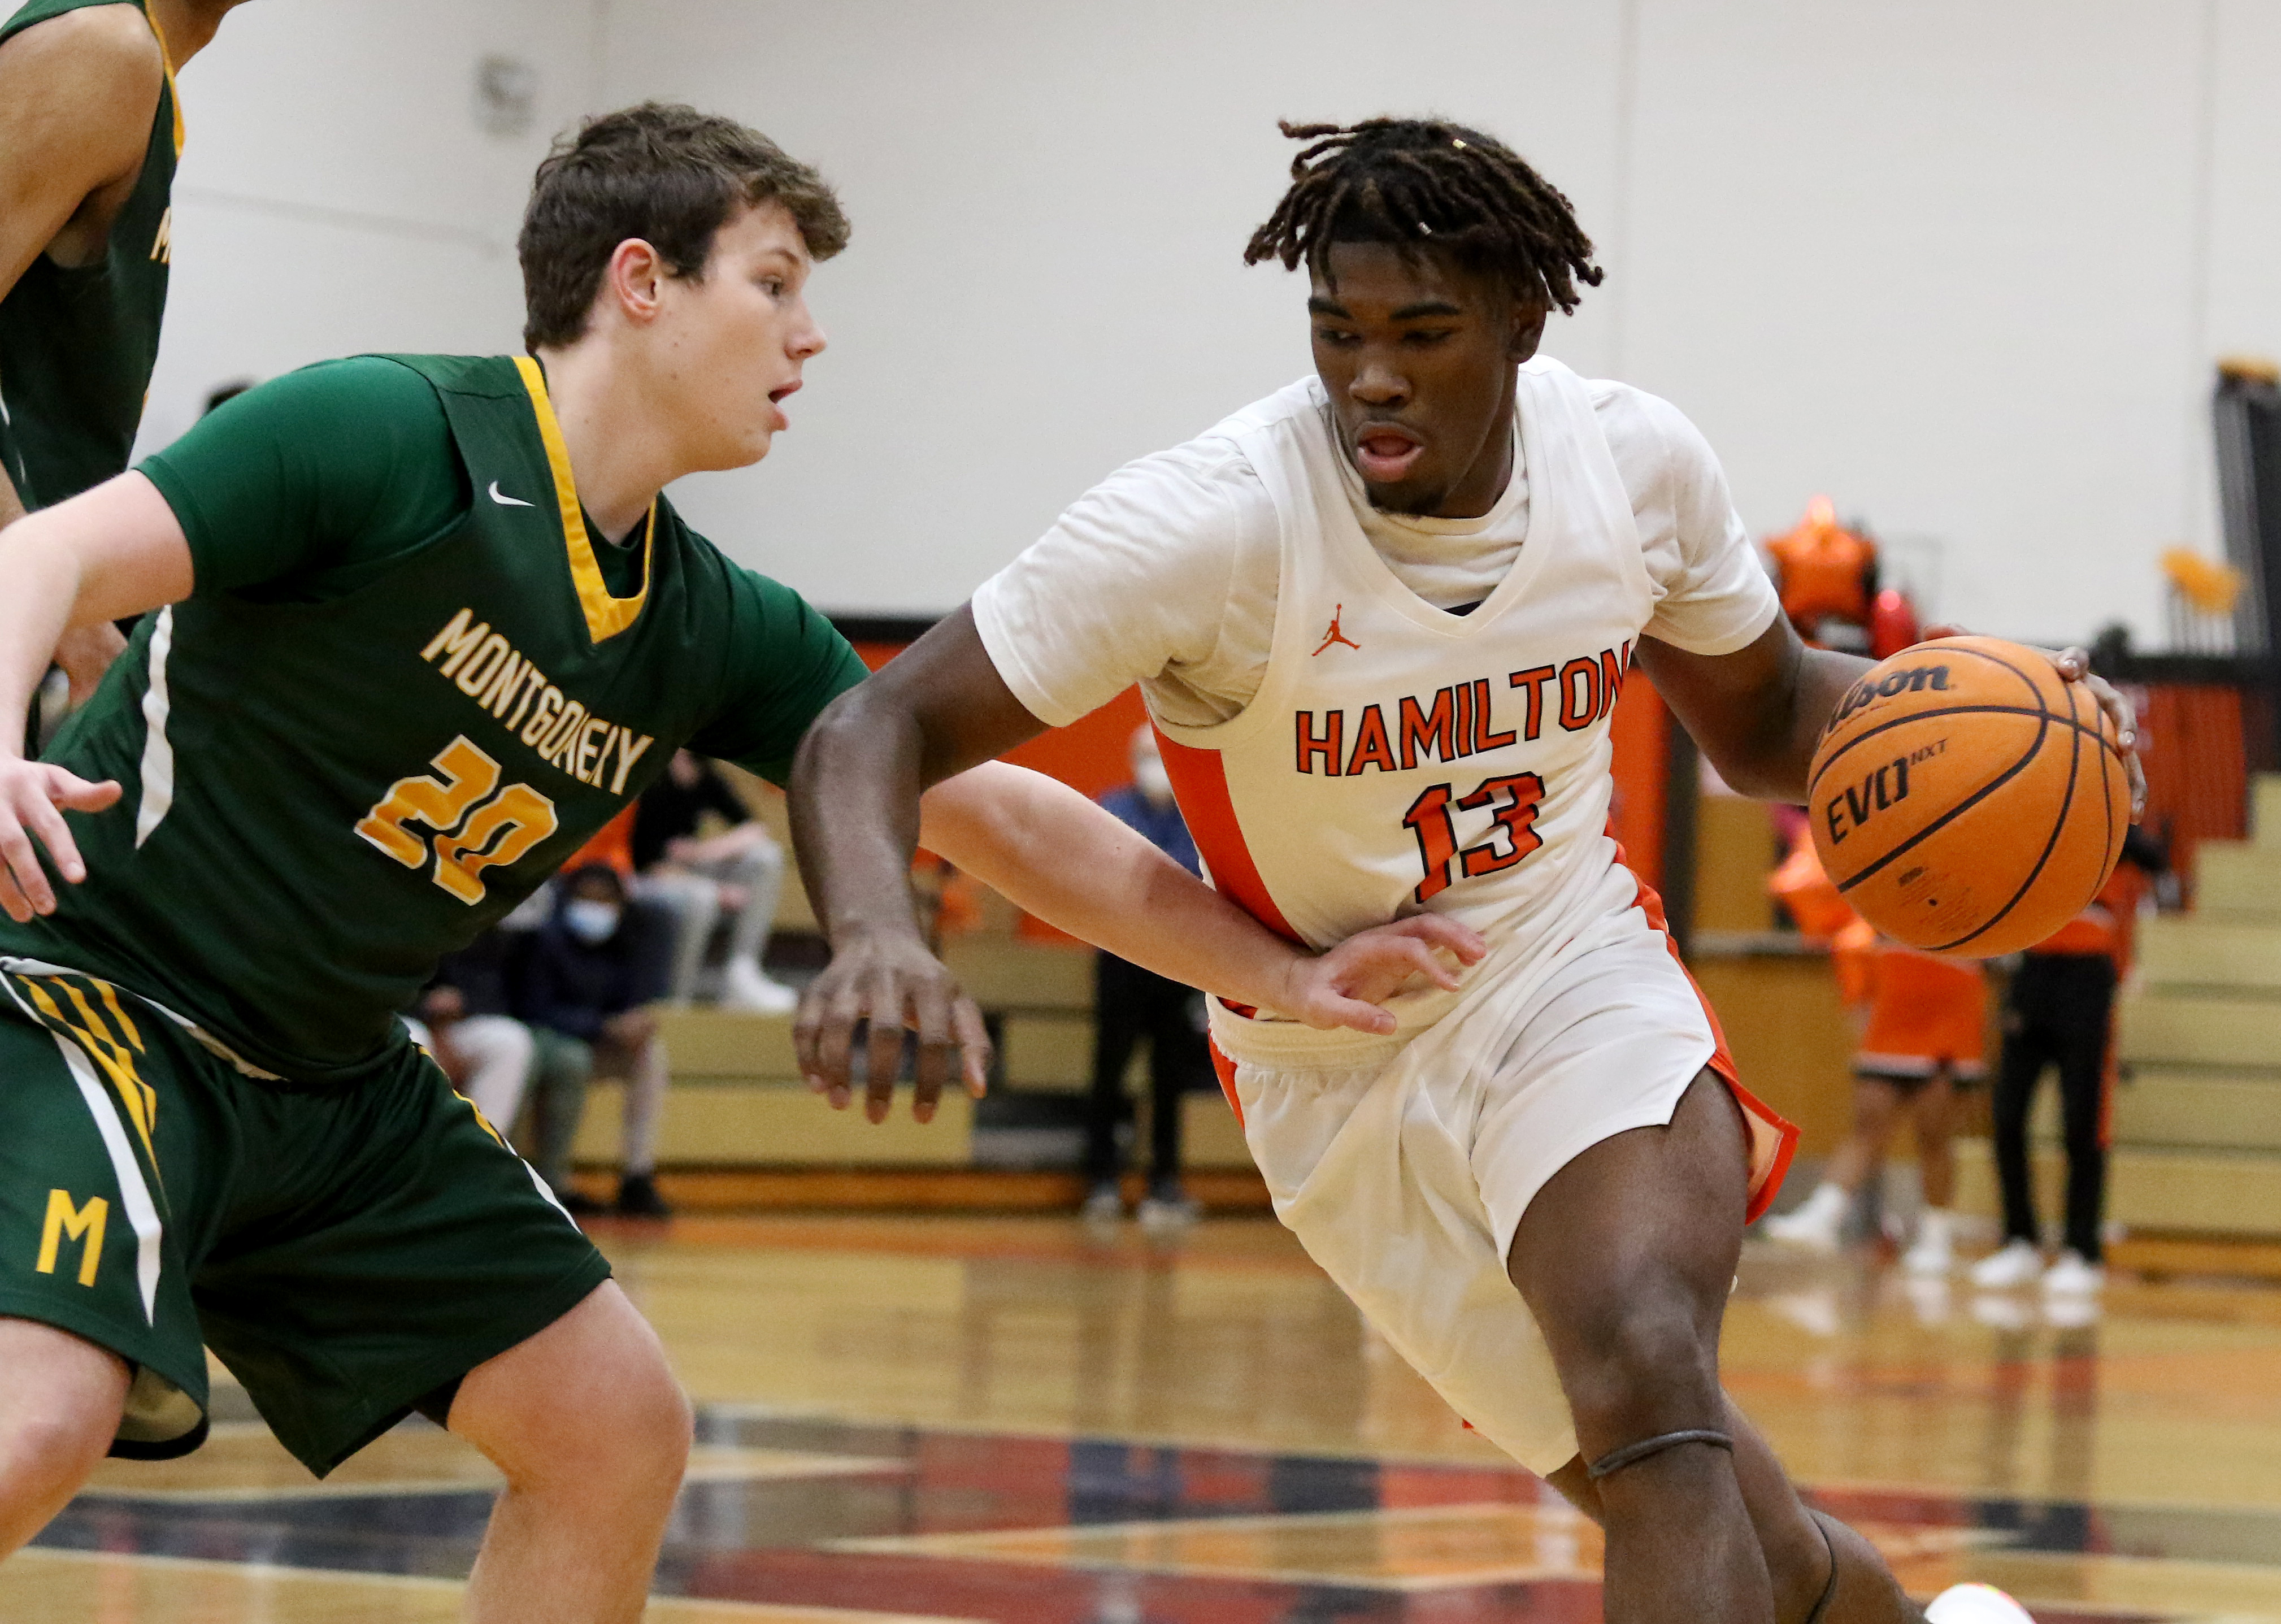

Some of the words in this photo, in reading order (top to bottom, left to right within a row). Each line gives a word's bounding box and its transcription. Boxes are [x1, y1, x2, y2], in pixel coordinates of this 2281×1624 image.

[1295, 639, 1631, 777] HAMILTON
[353, 734, 559, 906] 20
[1402, 771, 1546, 904] 13
[1827, 757, 1909, 845] EVO
[1911, 738, 1948, 766] NXT
[36, 1188, 109, 1288] M
